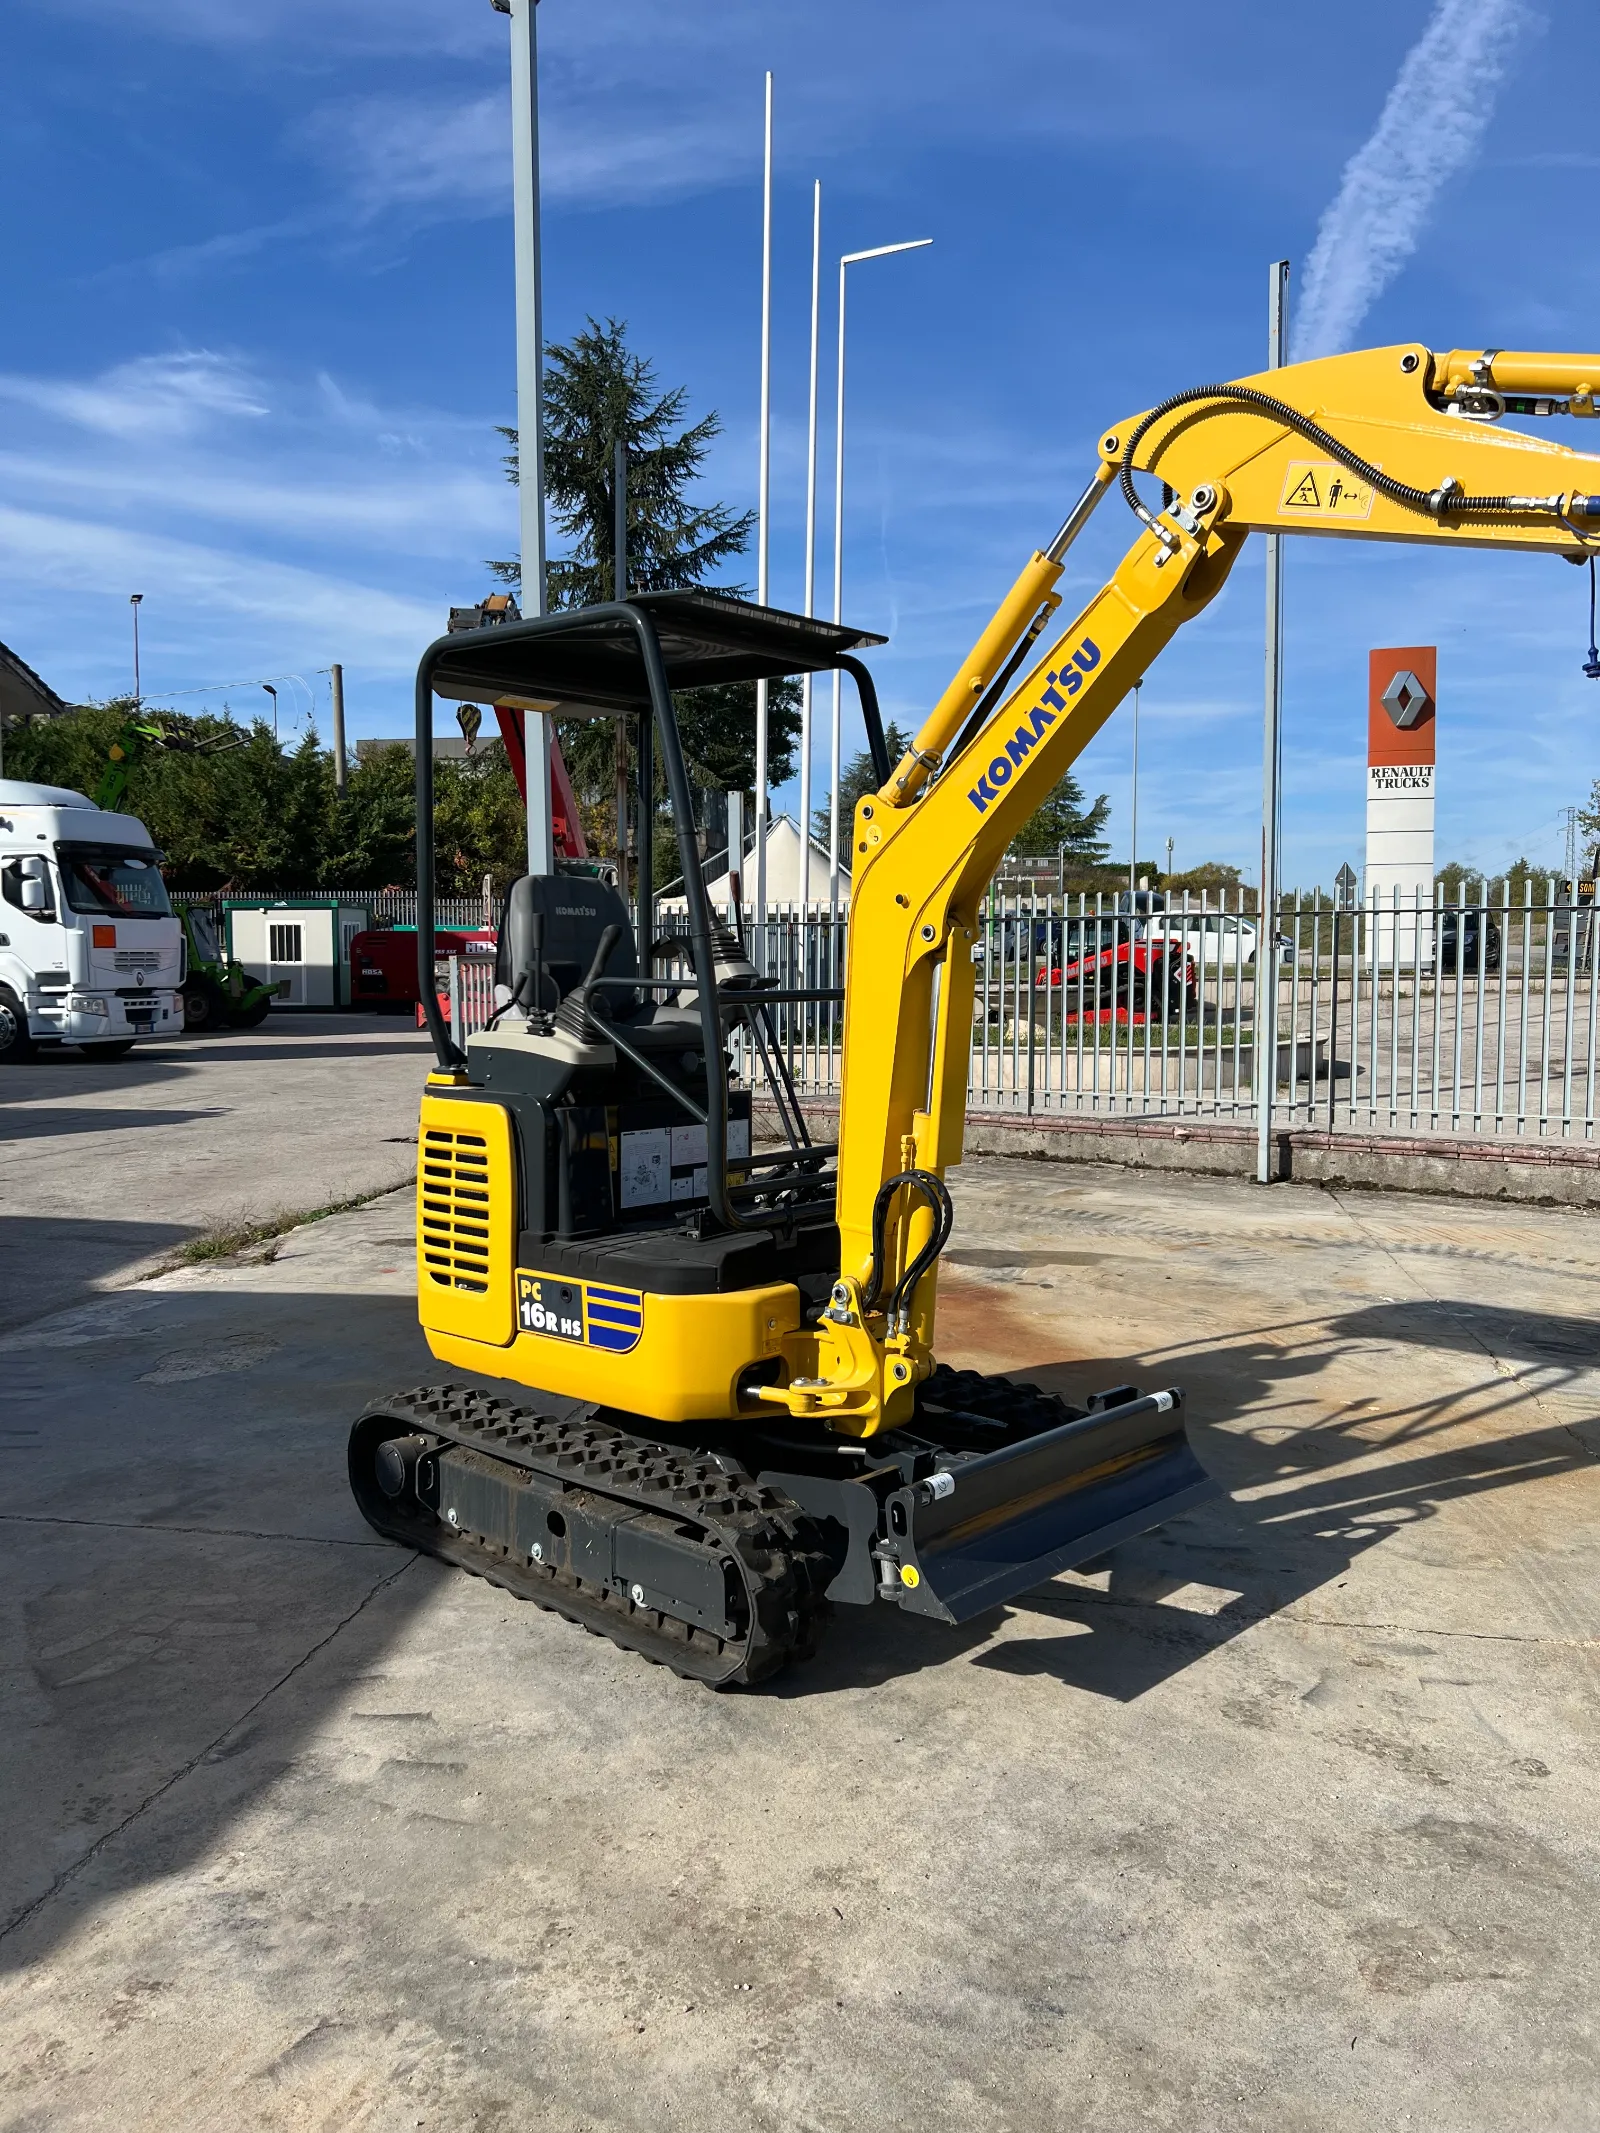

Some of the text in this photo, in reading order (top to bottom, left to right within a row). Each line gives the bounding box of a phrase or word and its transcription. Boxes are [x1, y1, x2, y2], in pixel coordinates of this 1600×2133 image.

[967, 636, 1101, 814] KOMATSU
[1371, 766, 1434, 778] RENAULT
[1375, 777, 1430, 789] TRUCKS
[555, 905, 597, 917] KOMATSU
[465, 941, 498, 954] MOS
[520, 1279, 542, 1302] PC
[520, 1301, 582, 1337] 16R HS
